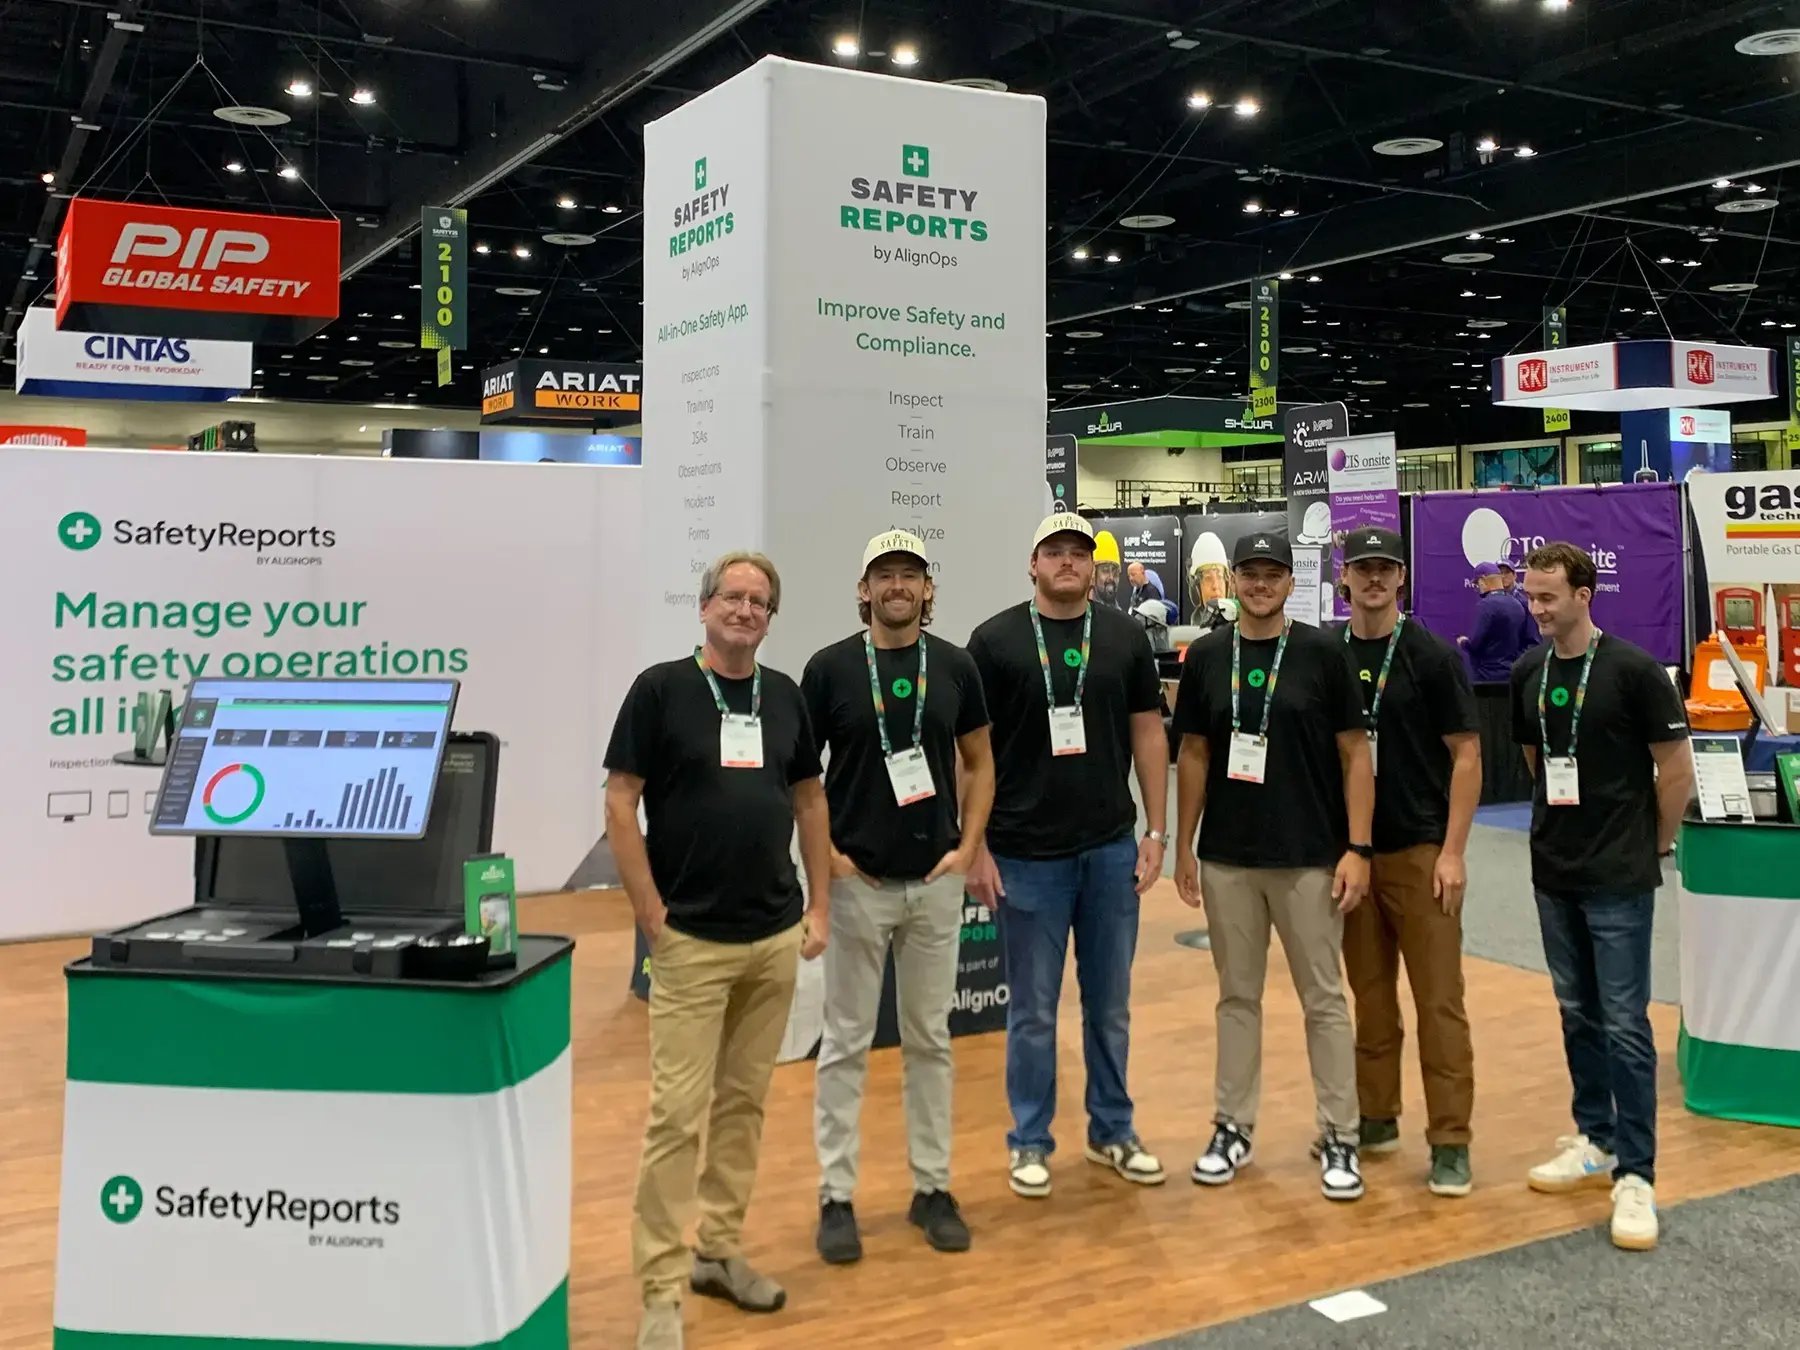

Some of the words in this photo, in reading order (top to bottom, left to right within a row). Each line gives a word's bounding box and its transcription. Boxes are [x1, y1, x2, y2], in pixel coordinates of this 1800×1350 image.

[850, 177, 978, 212] SAFETY
[674, 184, 730, 228] SAFETY
[840, 205, 988, 242] REPORTS
[669, 212, 735, 258] REPORTS
[110, 222, 270, 271] PIP
[873, 245, 891, 264] by
[894, 248, 958, 268] AlignOps
[682, 265, 690, 281] by
[689, 254, 720, 279] AlignOps
[102, 267, 204, 292] GLOBAL
[210, 275, 312, 298] SAFETY
[437, 243, 453, 326] 2100
[657, 315, 698, 343] All-in-One
[699, 308, 726, 332] Safety
[726, 302, 749, 324] App.
[818, 298, 900, 322] Improve
[906, 305, 966, 330] Safety
[970, 312, 1006, 330] and
[856, 332, 977, 358] Compliance.
[1260, 306, 1271, 371] 2300
[84, 334, 191, 364] CINTAS
[76, 361, 108, 370] READY
[134, 365, 151, 373] THE
[681, 363, 720, 384] Inspections
[1519, 362, 1547, 389] RKI
[1549, 360, 1600, 374] INSTRUMENTS
[1687, 353, 1713, 380] RKI
[1715, 361, 1758, 372] INSTRUMENTS
[483, 371, 515, 398] ARIAT
[536, 371, 640, 393] ARIAT
[488, 395, 508, 409] WORK
[556, 394, 621, 408] WORK
[686, 398, 714, 415] Training
[888, 391, 943, 410] Inspect
[1254, 396, 1275, 408] 2300
[1087, 421, 1123, 434] SHOWA
[1225, 419, 1274, 430] SHOWA
[1546, 413, 1568, 423] 2400
[691, 430, 708, 445] JSAs
[898, 425, 935, 440] Train
[1789, 434, 1799, 442] 25
[587, 443, 625, 453] ARIAT
[678, 460, 722, 479] Observations
[885, 456, 947, 474] Observe
[1344, 454, 1359, 468] CIS
[1362, 453, 1390, 467] onsite
[684, 494, 716, 508] Incidents
[890, 490, 942, 508] Report
[1725, 485, 1800, 519] ga
[113, 519, 336, 553] SafetyReports
[688, 527, 710, 540] Forms
[1726, 544, 1770, 555] Portable
[1772, 544, 1792, 555] Gas
[256, 556, 270, 566] BY
[271, 556, 322, 566] ALIGNOPS
[690, 560, 707, 573] Scan
[664, 591, 697, 609] Reporting
[54, 591, 252, 638] Manage
[263, 600, 367, 637] your
[51, 644, 210, 688] safety
[222, 641, 469, 678] operations
[50, 697, 104, 735] all
[49, 758, 119, 769] Inspection
[966, 959, 986, 973] part
[988, 956, 999, 969] of
[155, 1186, 400, 1230] SafetyReports
[309, 1235, 323, 1247] BY
[326, 1235, 384, 1248] ALIGNOPS
